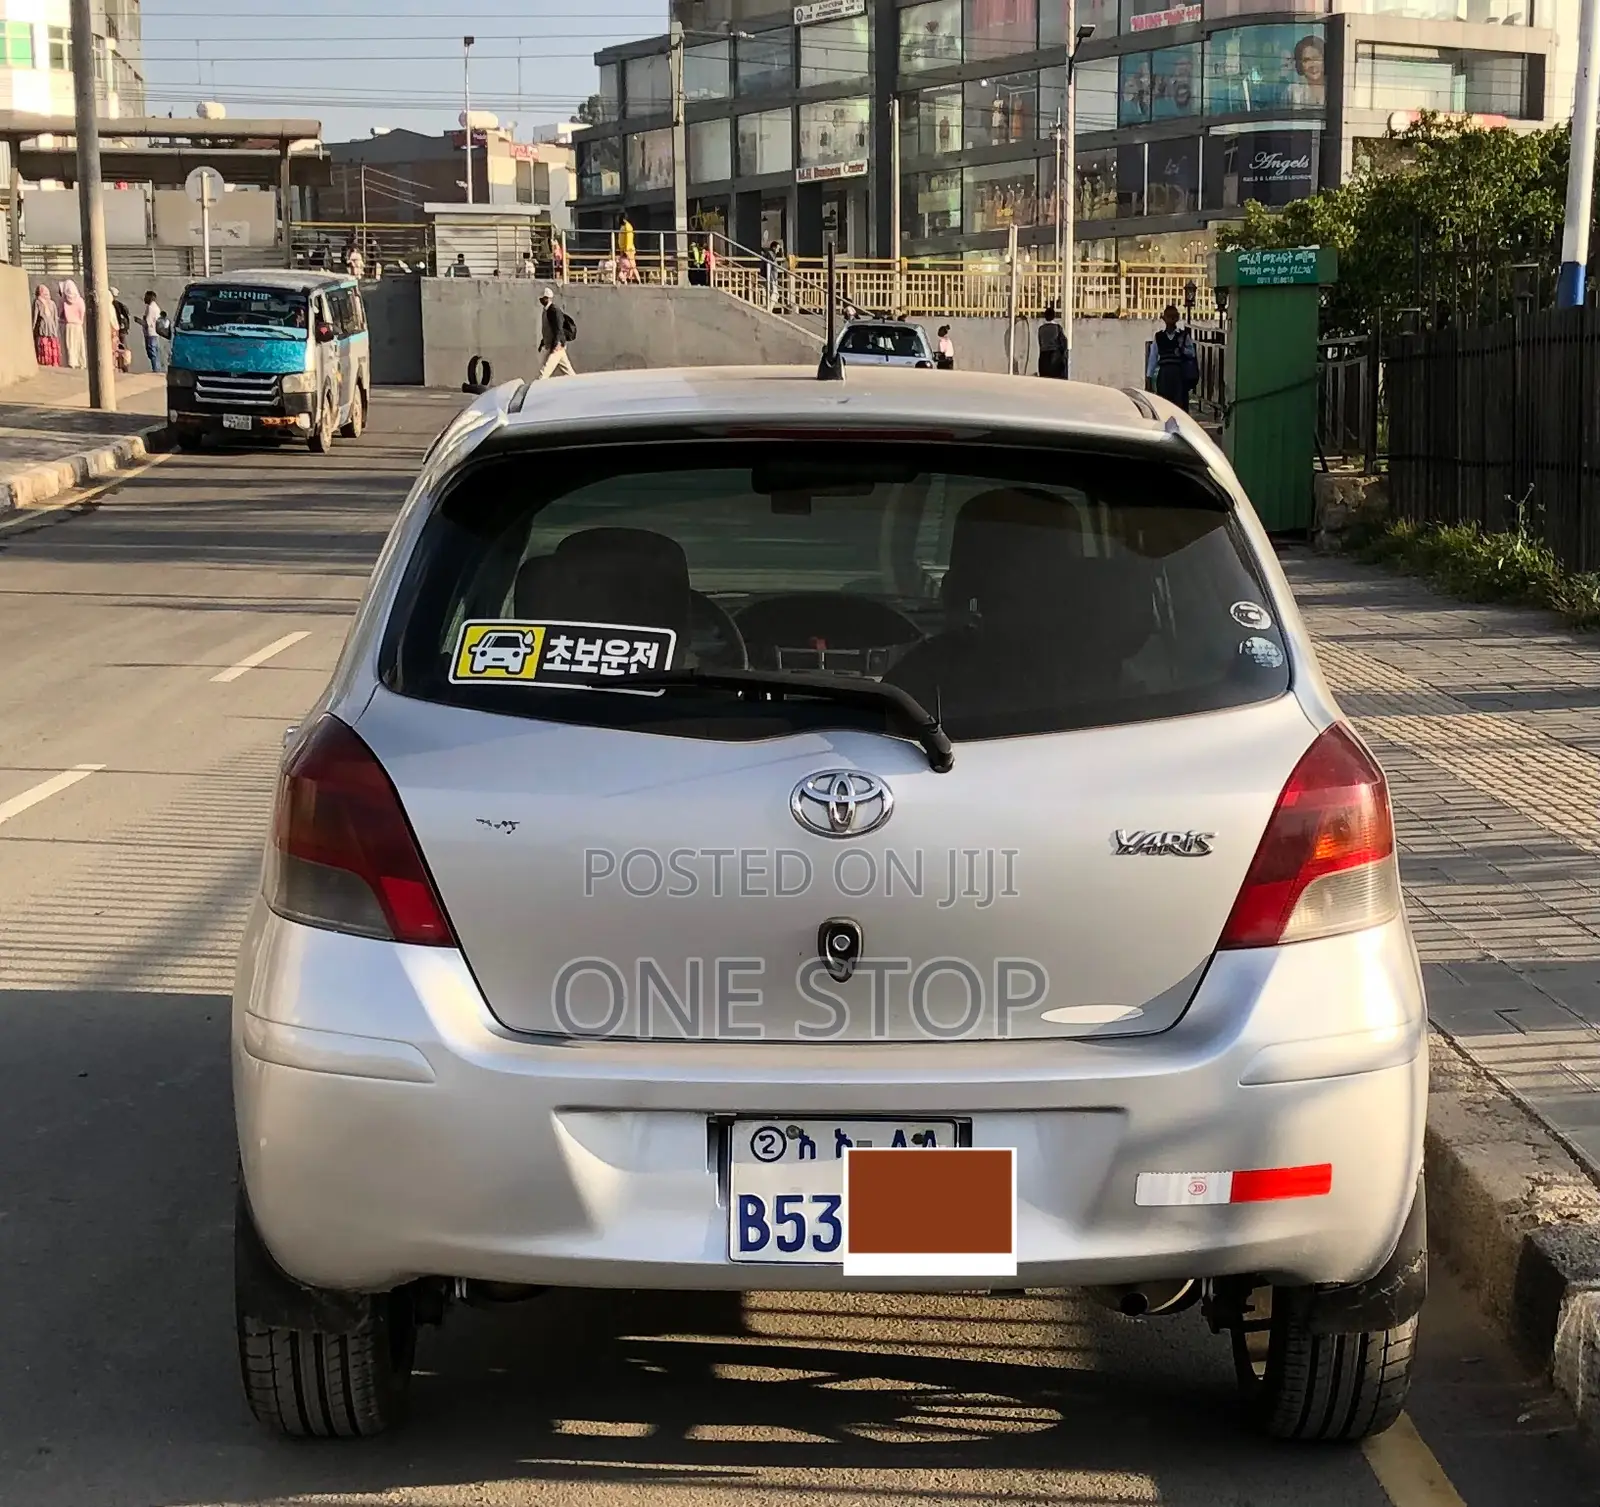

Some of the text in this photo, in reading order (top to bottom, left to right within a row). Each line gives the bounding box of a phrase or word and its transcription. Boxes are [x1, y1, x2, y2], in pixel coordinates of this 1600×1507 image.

[813, 165, 841, 178] Business
[843, 162, 864, 173] Center
[1249, 151, 1310, 175] Angels
[542, 634, 659, 676] 초보운전
